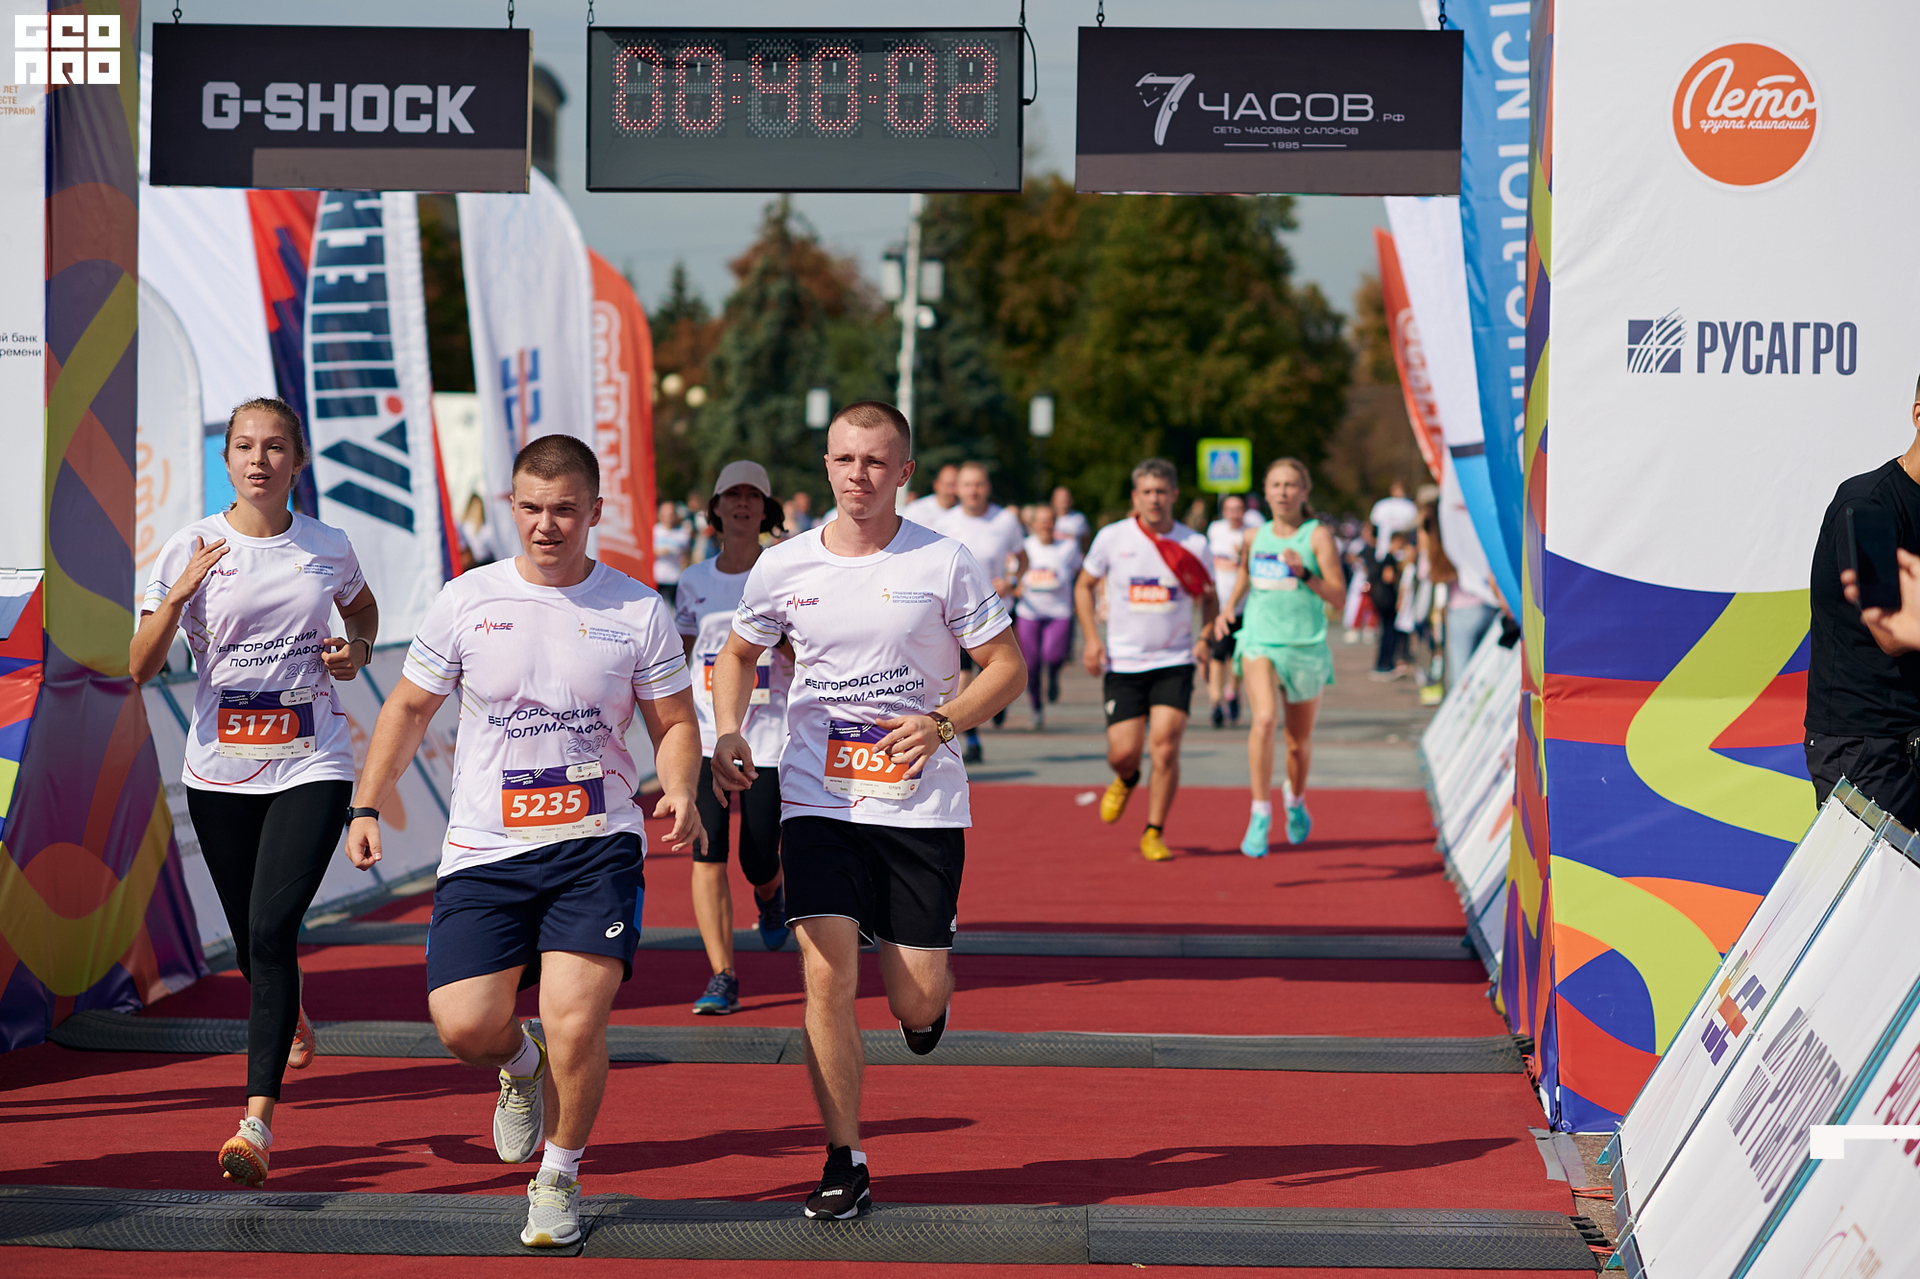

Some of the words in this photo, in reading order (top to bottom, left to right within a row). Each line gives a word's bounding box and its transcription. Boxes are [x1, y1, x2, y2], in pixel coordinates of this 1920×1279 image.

[614, 46, 995, 131] 00:40:02
[1682, 57, 1816, 129] Лето
[202, 82, 475, 133] G-SHOCK
[1198, 93, 1374, 122] ЧАСОВ
[1213, 126, 1241, 134] СЕТЬ
[1244, 126, 1300, 135] ЧАСОВЫХ
[1304, 127, 1359, 135] САЛОНОВ
[12, 332, 38, 343] банк
[1697, 321, 1857, 375] РУСАГРО
[230, 645, 326, 667] ПОЛУМАРАФОН
[285, 659, 324, 680] 2021
[805, 665, 909, 691] БЕЛГОРОДСКИЙ
[225, 713, 290, 736] 5171
[510, 789, 582, 818] 5235
